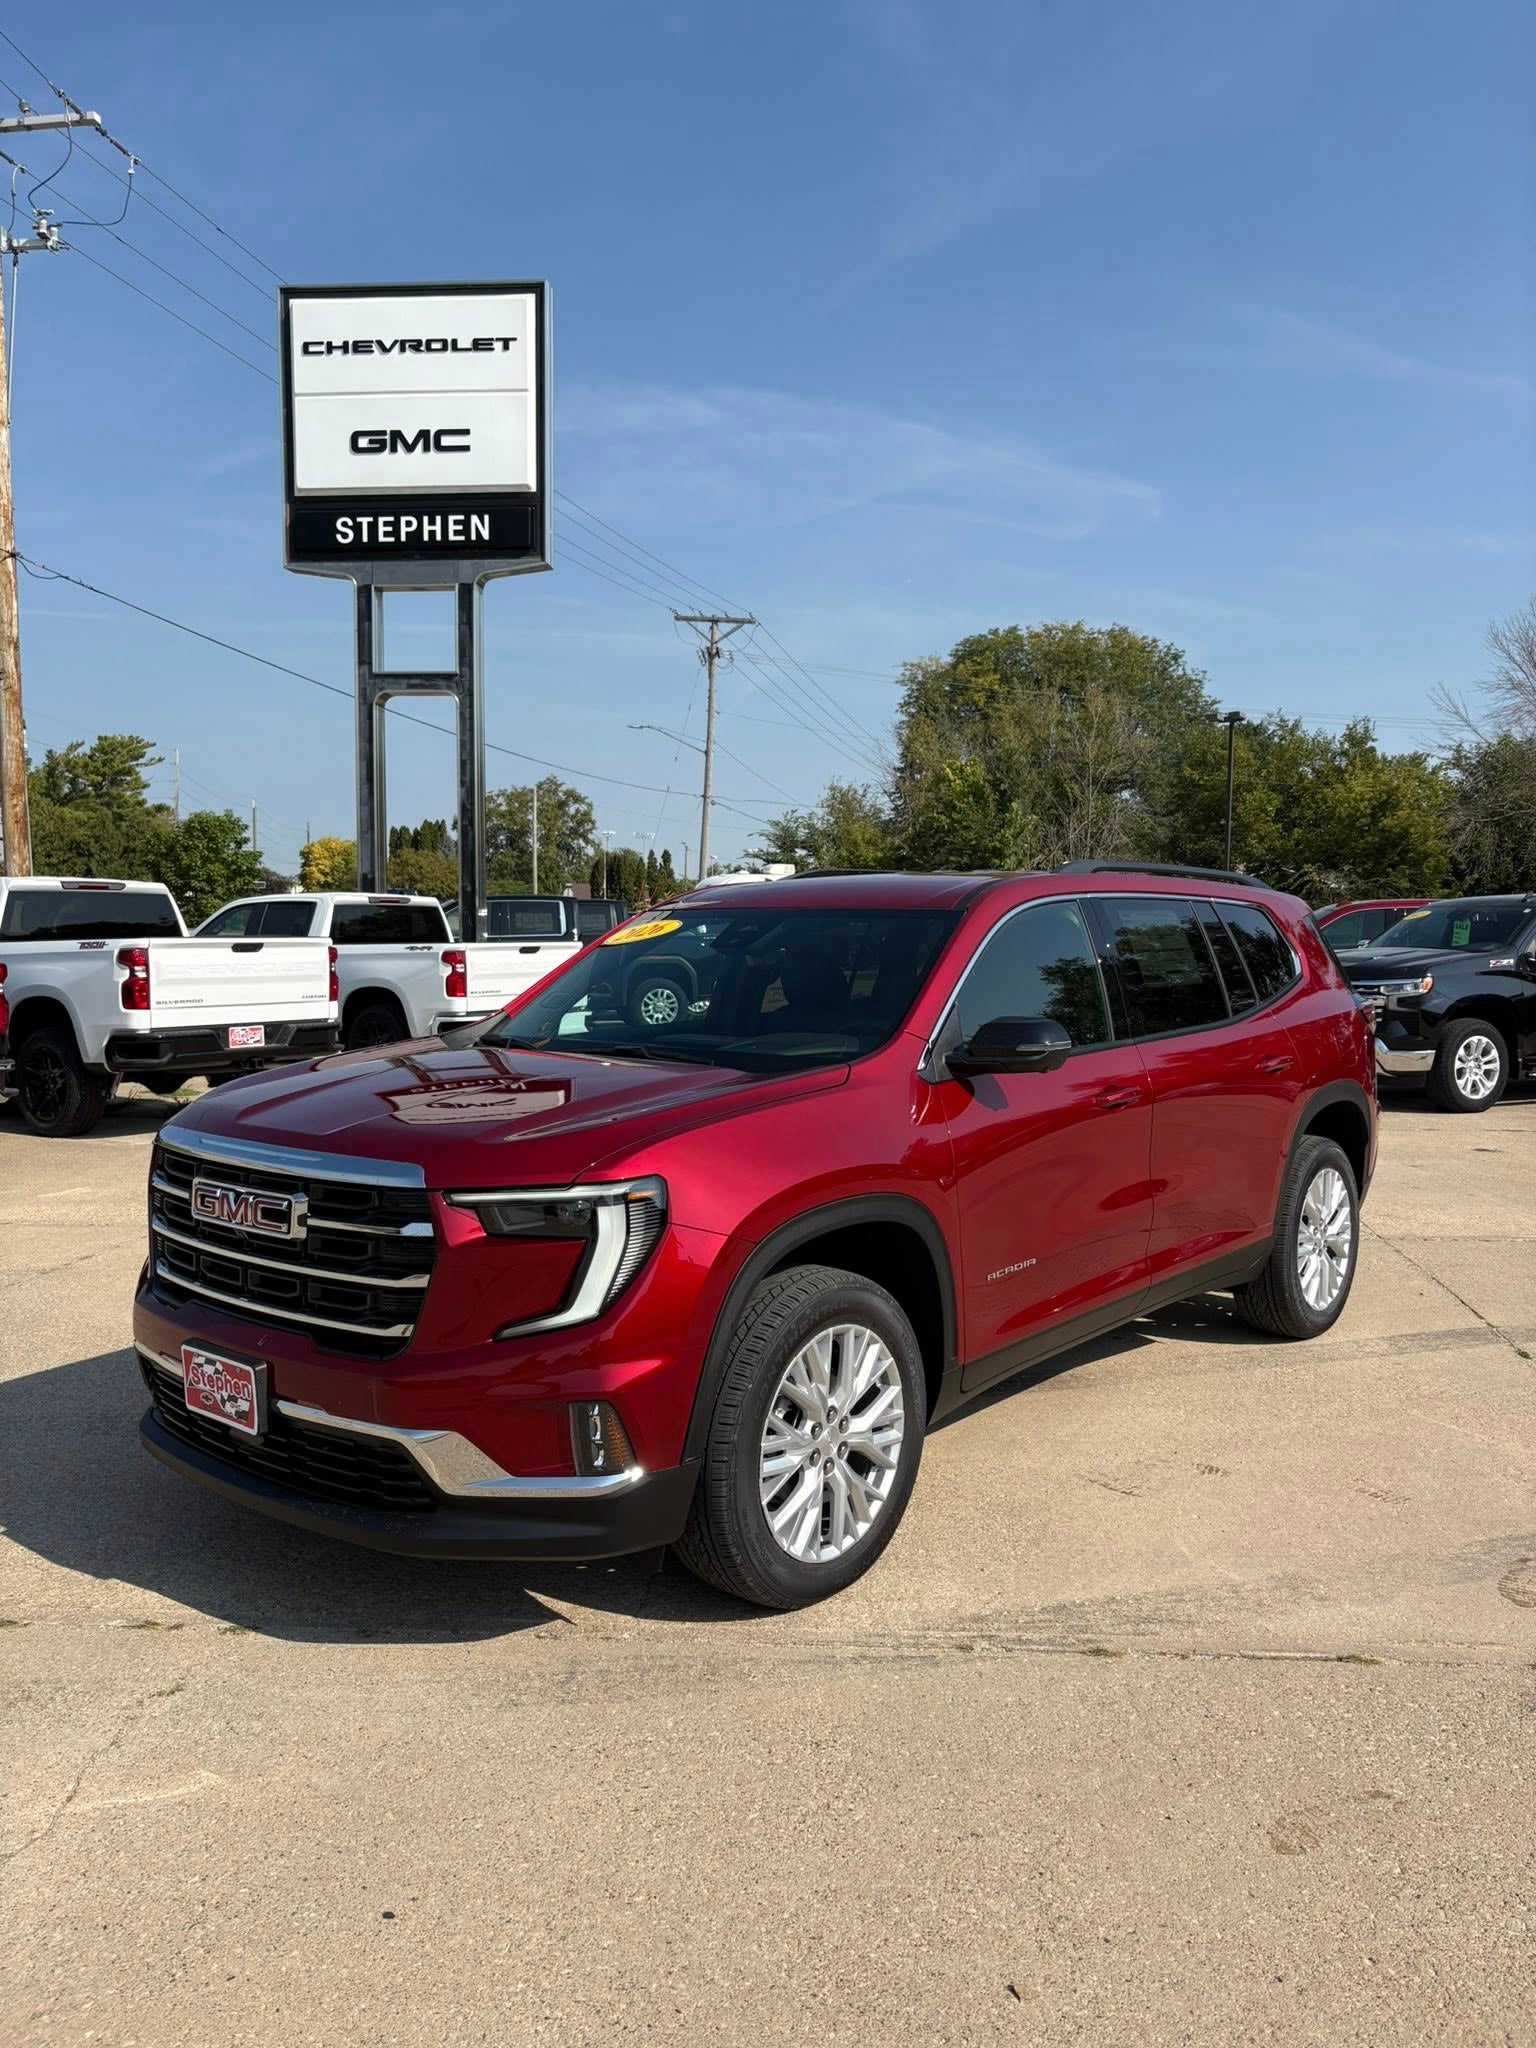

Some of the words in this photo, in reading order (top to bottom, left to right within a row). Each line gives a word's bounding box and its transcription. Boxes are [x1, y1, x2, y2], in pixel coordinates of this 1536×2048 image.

[302, 337, 517, 355] CHEVROLET
[350, 428, 471, 454] GMC
[335, 514, 490, 544] STEPHEN
[155, 998, 204, 1006] SILVERADO
[193, 1185, 290, 1233] GMC
[986, 1258, 1037, 1281] ACADIA
[190, 1364, 252, 1400] Stephen
